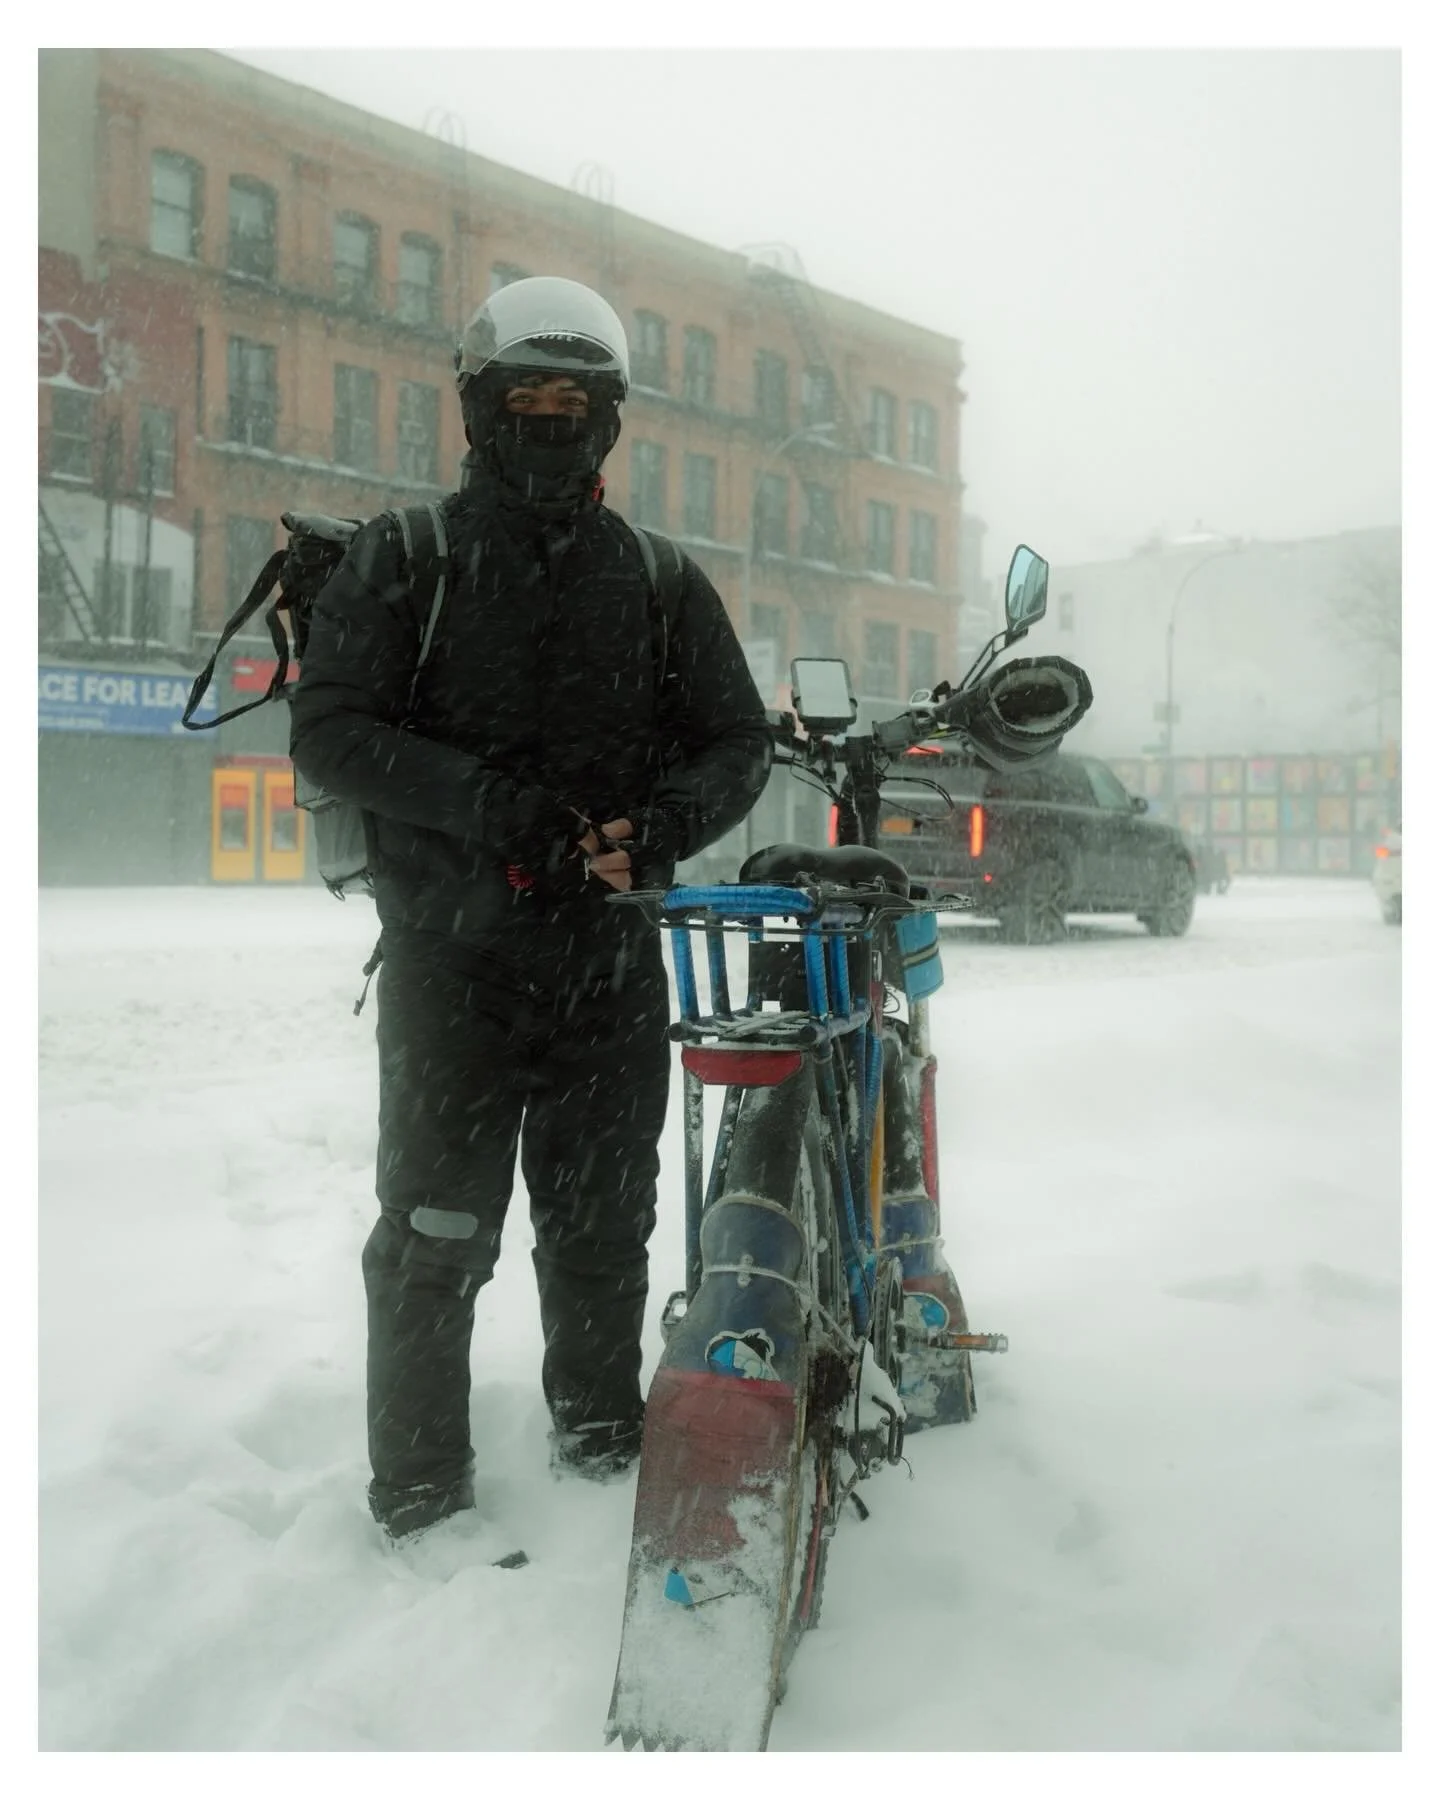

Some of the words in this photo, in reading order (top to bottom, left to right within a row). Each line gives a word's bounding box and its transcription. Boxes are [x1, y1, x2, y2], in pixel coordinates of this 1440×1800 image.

[38, 673, 79, 701] CE
[83, 676, 137, 706] FOR
[142, 679, 217, 710] LEAE
